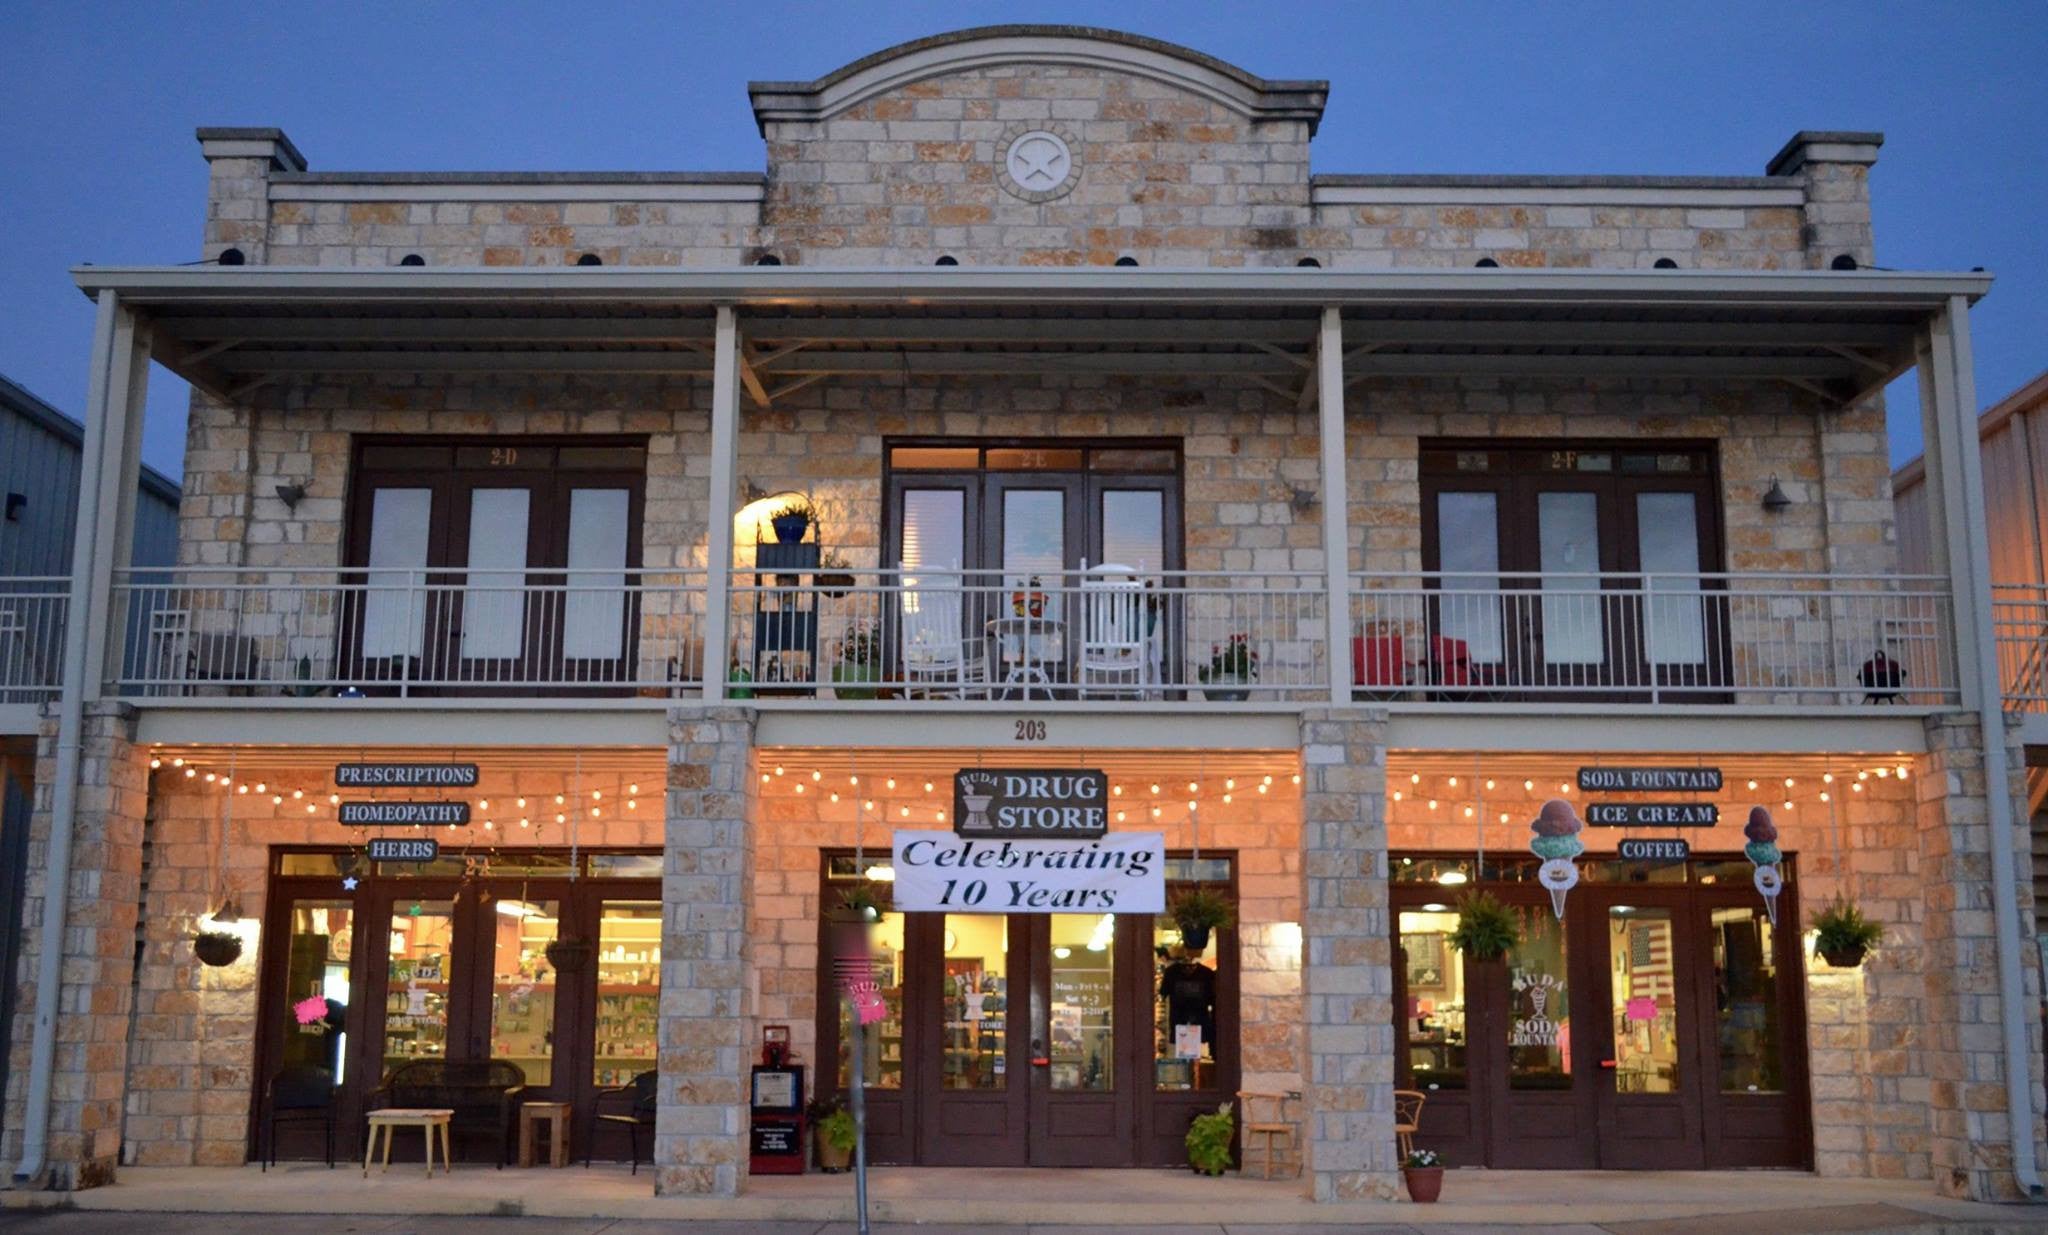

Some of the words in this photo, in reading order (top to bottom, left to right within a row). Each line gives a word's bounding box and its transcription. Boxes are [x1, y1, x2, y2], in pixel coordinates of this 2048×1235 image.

[490, 448, 517, 465] 2-D
[1551, 450, 1577, 469] 2-F
[1015, 719, 1047, 740] 203
[339, 767, 474, 782] PRESCRIPTIONS
[960, 772, 998, 788] BUDA
[1581, 771, 1625, 787] SODA
[1631, 771, 1718, 787] FOUNTAIN
[1004, 776, 1099, 799] DRUG
[344, 805, 464, 821] HOMEOPATHY
[997, 806, 1105, 829] STORE
[1591, 806, 1628, 821] ICE
[1637, 806, 1713, 822] CREAM
[372, 841, 433, 857] HERBS
[1622, 842, 1685, 858] COFFEE
[901, 839, 1155, 877] Celebrating
[937, 879, 987, 906] 10
[1006, 880, 1118, 907] Years
